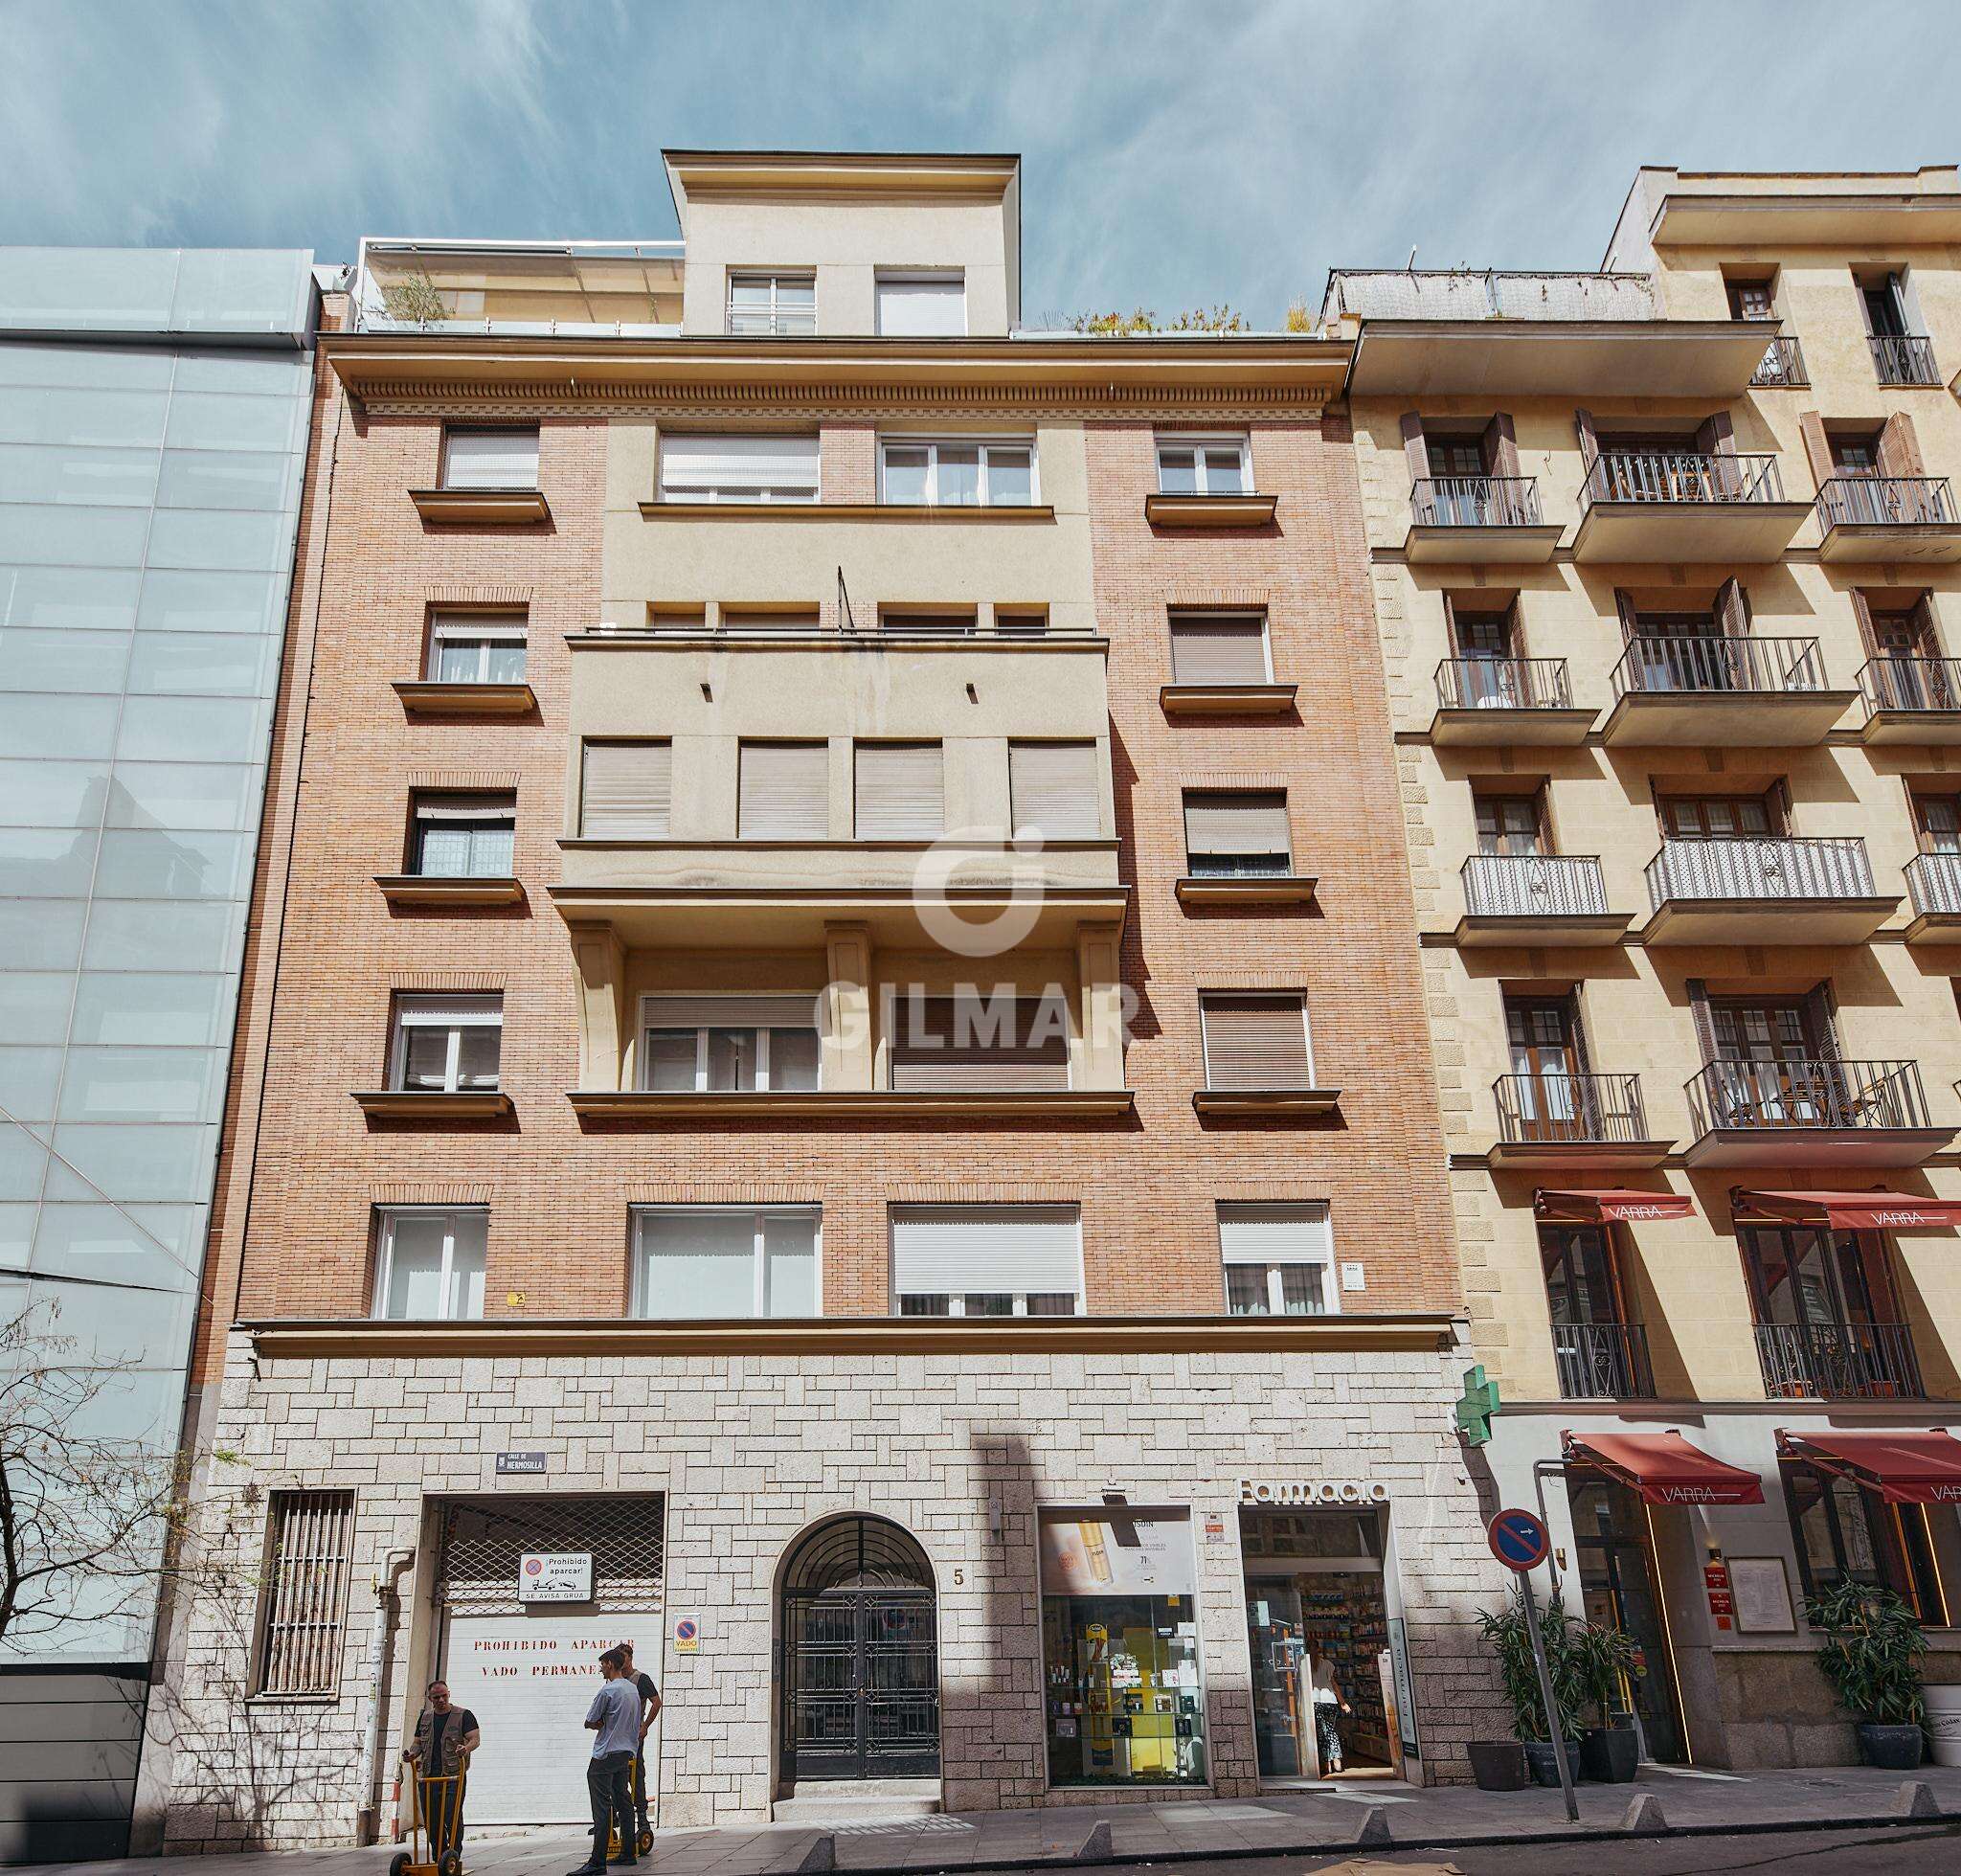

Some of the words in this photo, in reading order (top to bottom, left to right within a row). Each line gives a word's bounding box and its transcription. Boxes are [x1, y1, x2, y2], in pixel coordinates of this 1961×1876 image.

[1609, 1206, 1663, 1219] VARRA
[1870, 1211, 1926, 1226] VARRA
[507, 1460, 543, 1470] HERMOSILLA
[1237, 1479, 1390, 1503] Farmacia
[1661, 1486, 1716, 1502] VARRA
[1930, 1485, 1961, 1501] VAR
[954, 1569, 963, 1585] 5
[474, 1639, 558, 1651] PROHIBIDO
[572, 1639, 634, 1650] APARCR
[483, 1666, 518, 1677] VADO
[531, 1665, 602, 1676] PERMANE
